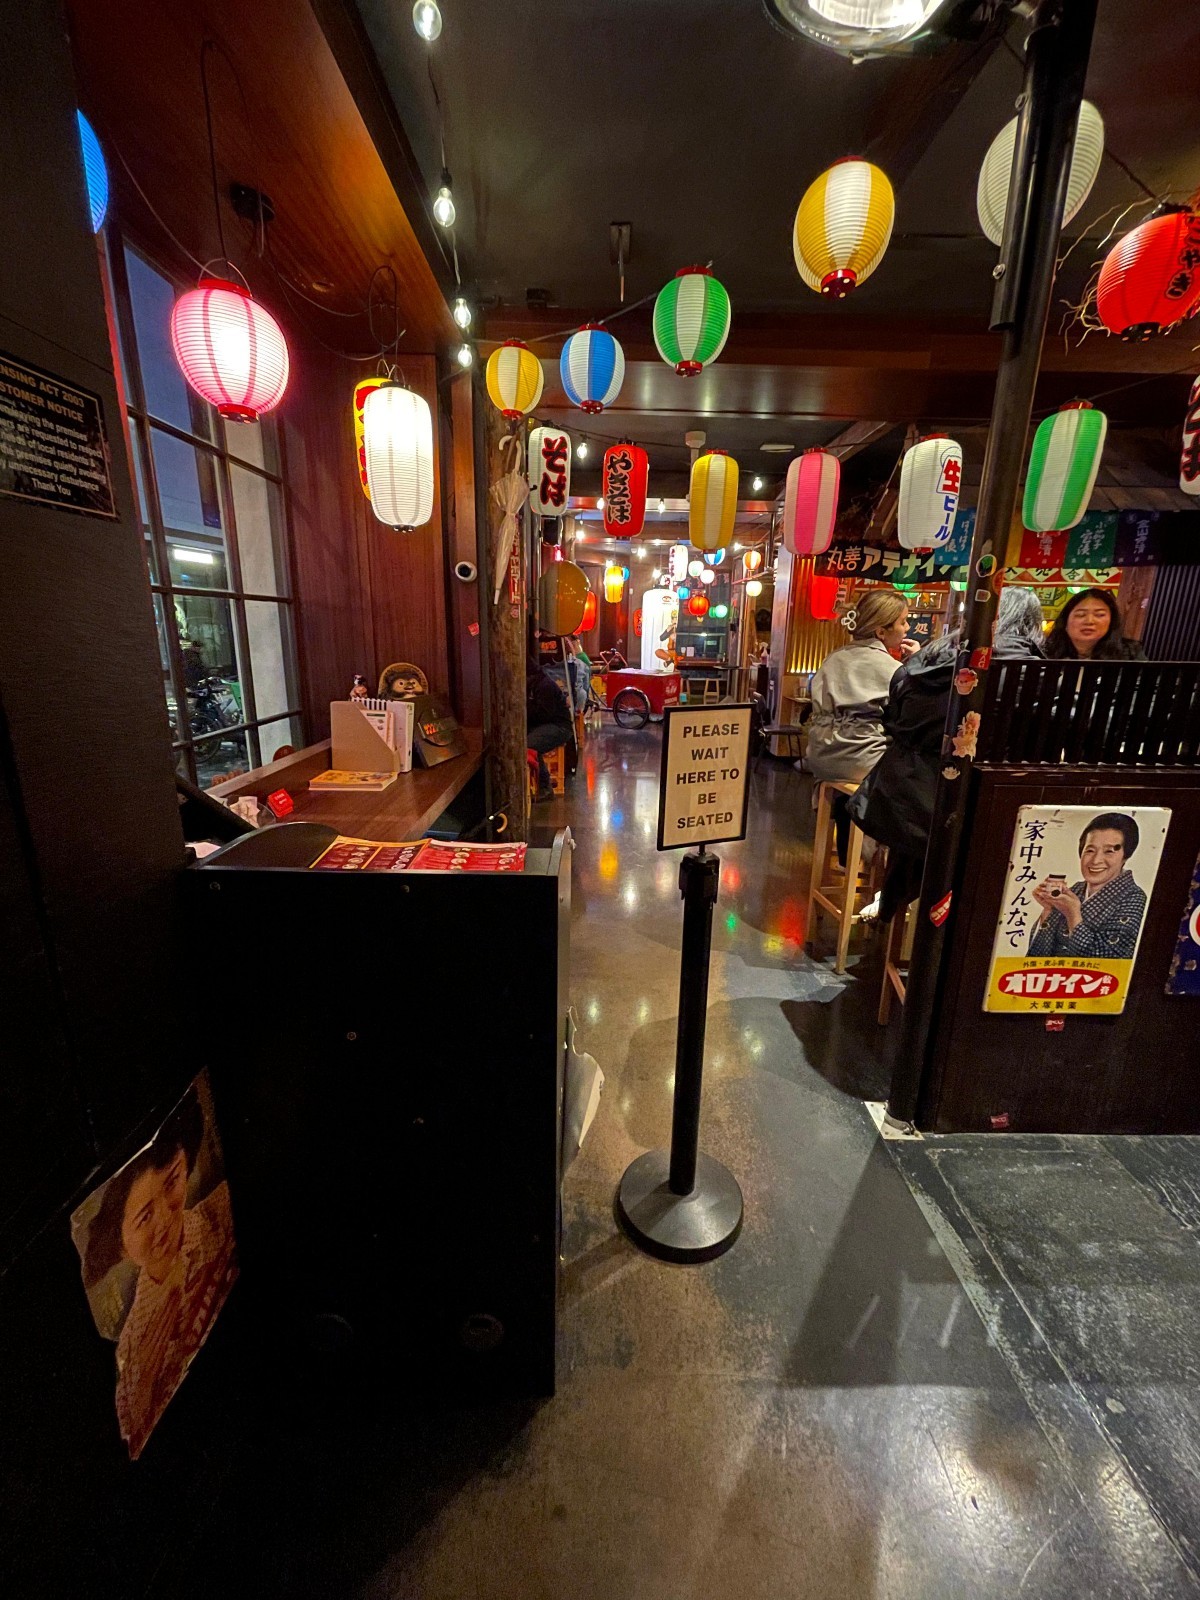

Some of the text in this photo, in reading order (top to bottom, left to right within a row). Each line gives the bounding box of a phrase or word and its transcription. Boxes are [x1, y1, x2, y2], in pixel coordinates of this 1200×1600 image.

[38, 380, 59, 397] ACT
[47, 399, 84, 423] NOTICE
[16, 423, 29, 434] are
[31, 427, 68, 448] requested
[69, 440, 77, 449] to
[55, 422, 87, 443] premises
[15, 448, 52, 468] premises
[540, 436, 567, 507] そば
[31, 477, 71, 496] Thank You
[59, 473, 99, 492] disturbance
[606, 451, 634, 524] やきそば
[934, 459, 961, 540] 生ビール
[828, 546, 968, 579] 丸善アテナイ
[683, 723, 739, 738] PLEASE
[691, 747, 729, 761] WAIT
[676, 768, 739, 785] HERE TO
[697, 792, 717, 805] BE
[677, 812, 733, 829] SEATED
[1005, 819, 1048, 948] 家中みんなで
[1004, 973, 1103, 994] オロナイン
[1029, 1001, 1078, 1010] 大塚製薬
